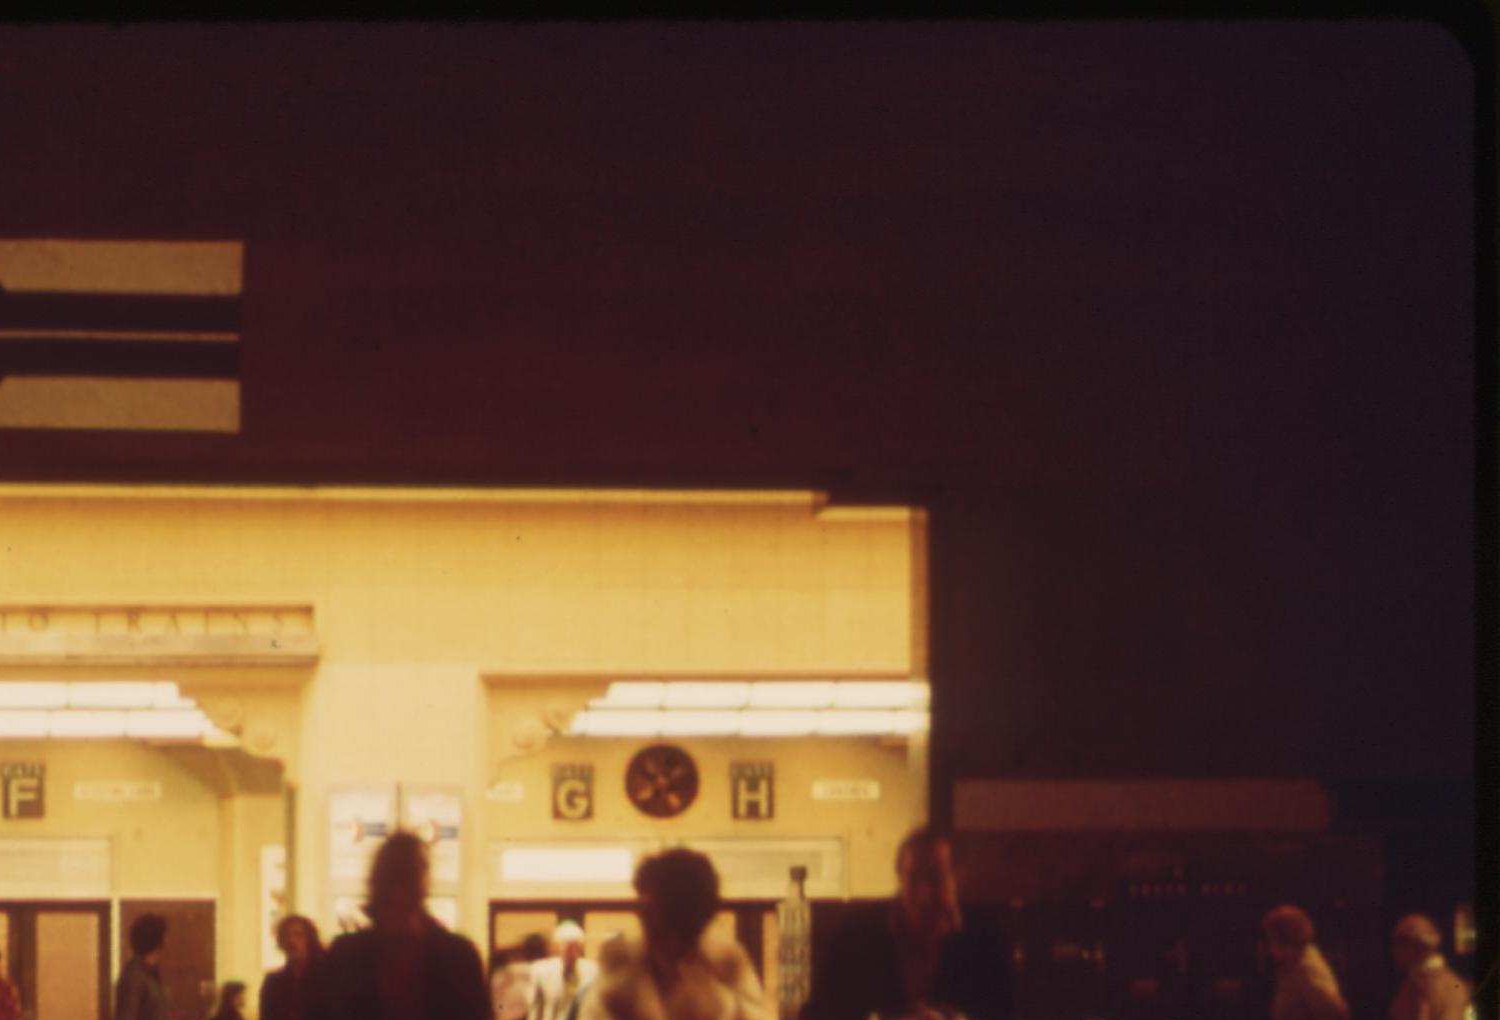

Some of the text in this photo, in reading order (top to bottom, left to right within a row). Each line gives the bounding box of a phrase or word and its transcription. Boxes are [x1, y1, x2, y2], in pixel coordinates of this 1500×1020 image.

[8, 778, 40, 817] F
[557, 779, 588, 818] G
[738, 779, 769, 817] H
